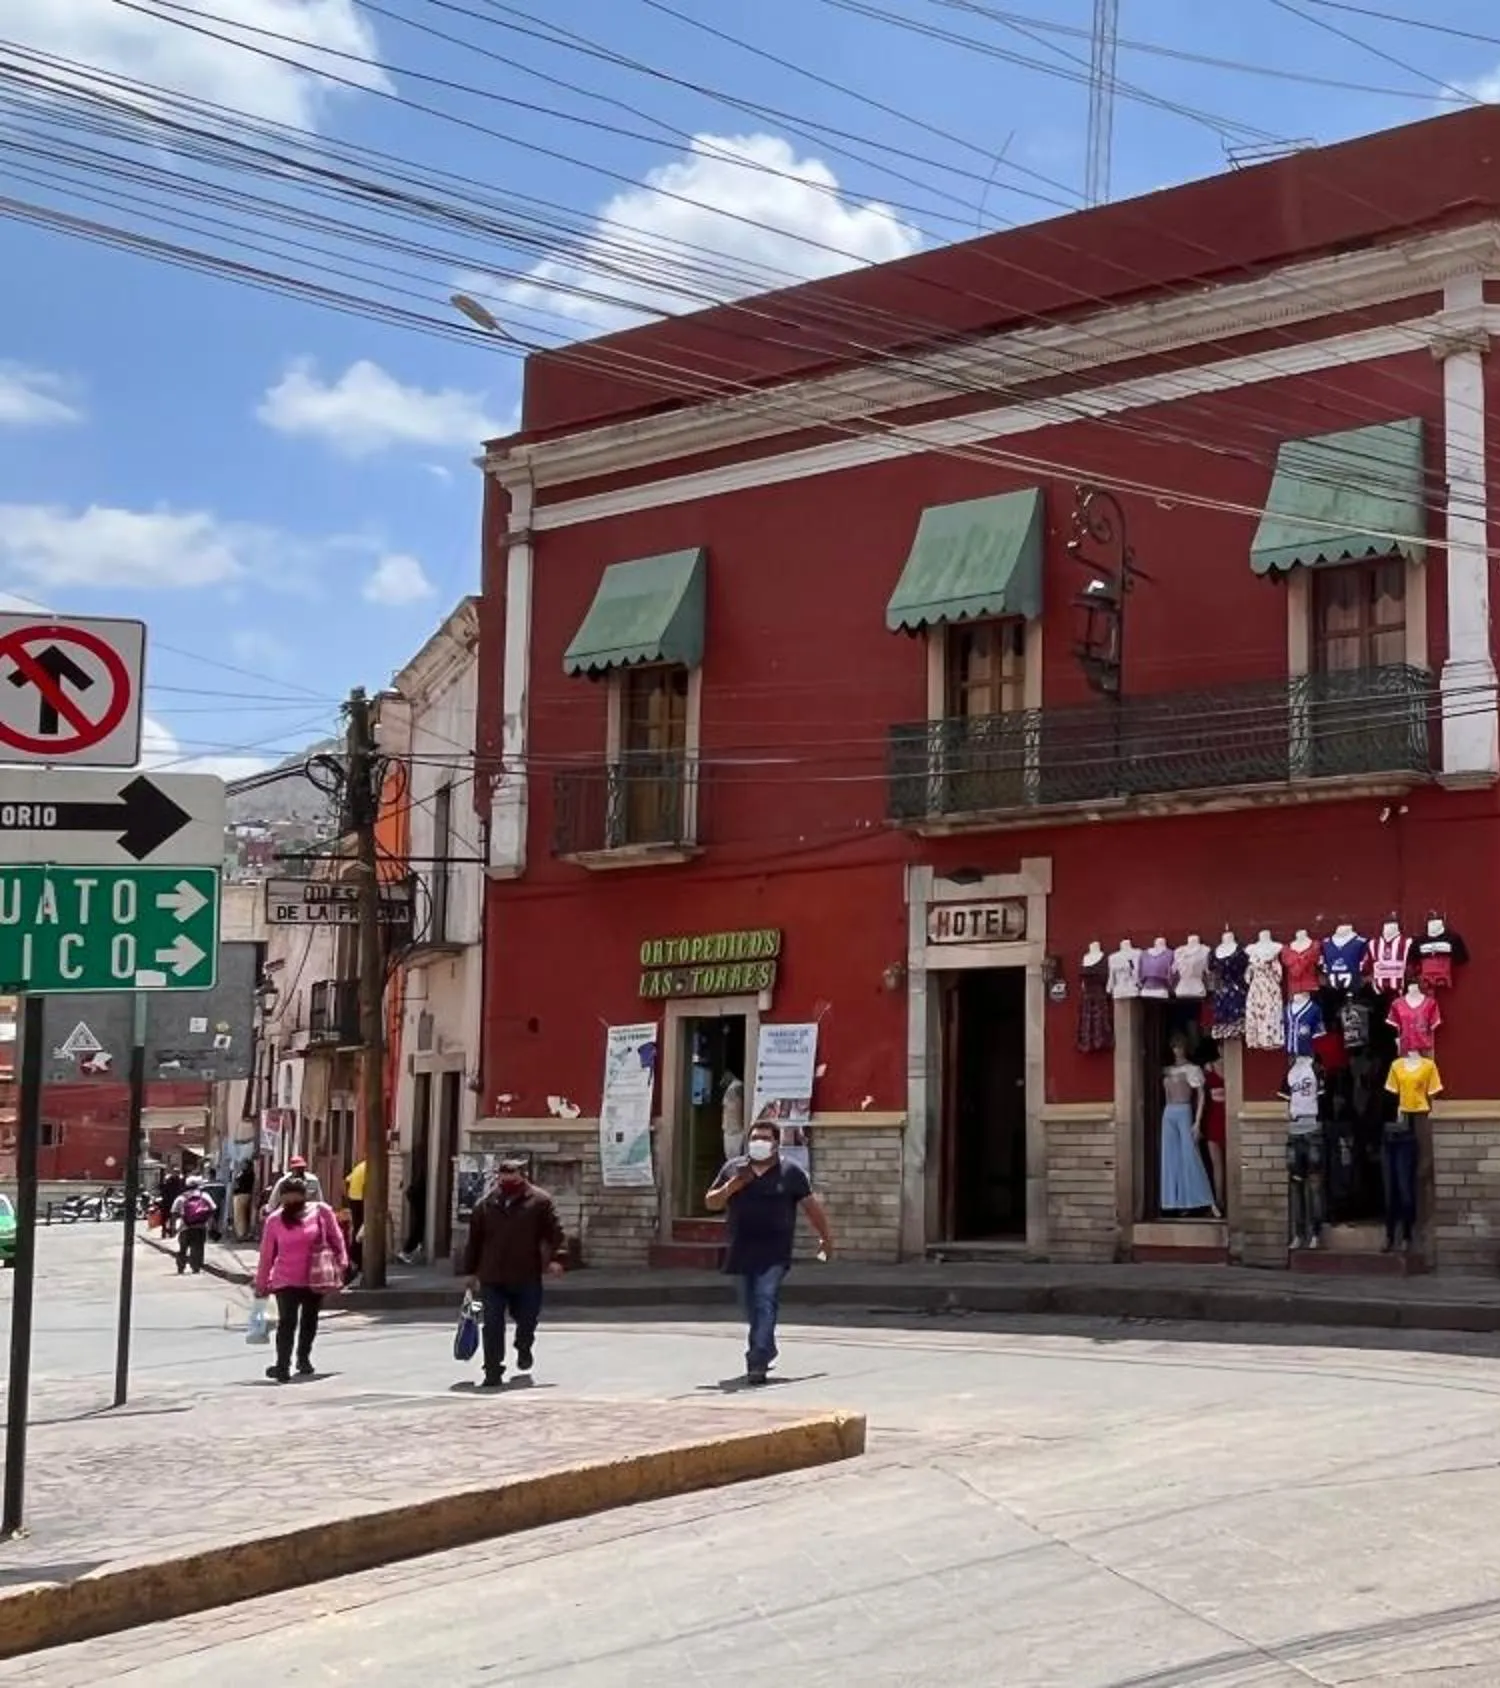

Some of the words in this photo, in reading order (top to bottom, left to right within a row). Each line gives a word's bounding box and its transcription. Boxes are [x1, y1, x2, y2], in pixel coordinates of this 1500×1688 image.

[1, 805, 57, 827] ORIO
[276, 905, 299, 920] DE
[307, 905, 329, 920] LA
[936, 907, 1018, 938] HOTEL
[22, 933, 136, 980] ICO
[640, 930, 776, 965] ORTOPEDICOS
[639, 972, 673, 996] LAS
[690, 963, 770, 993] TORRES
